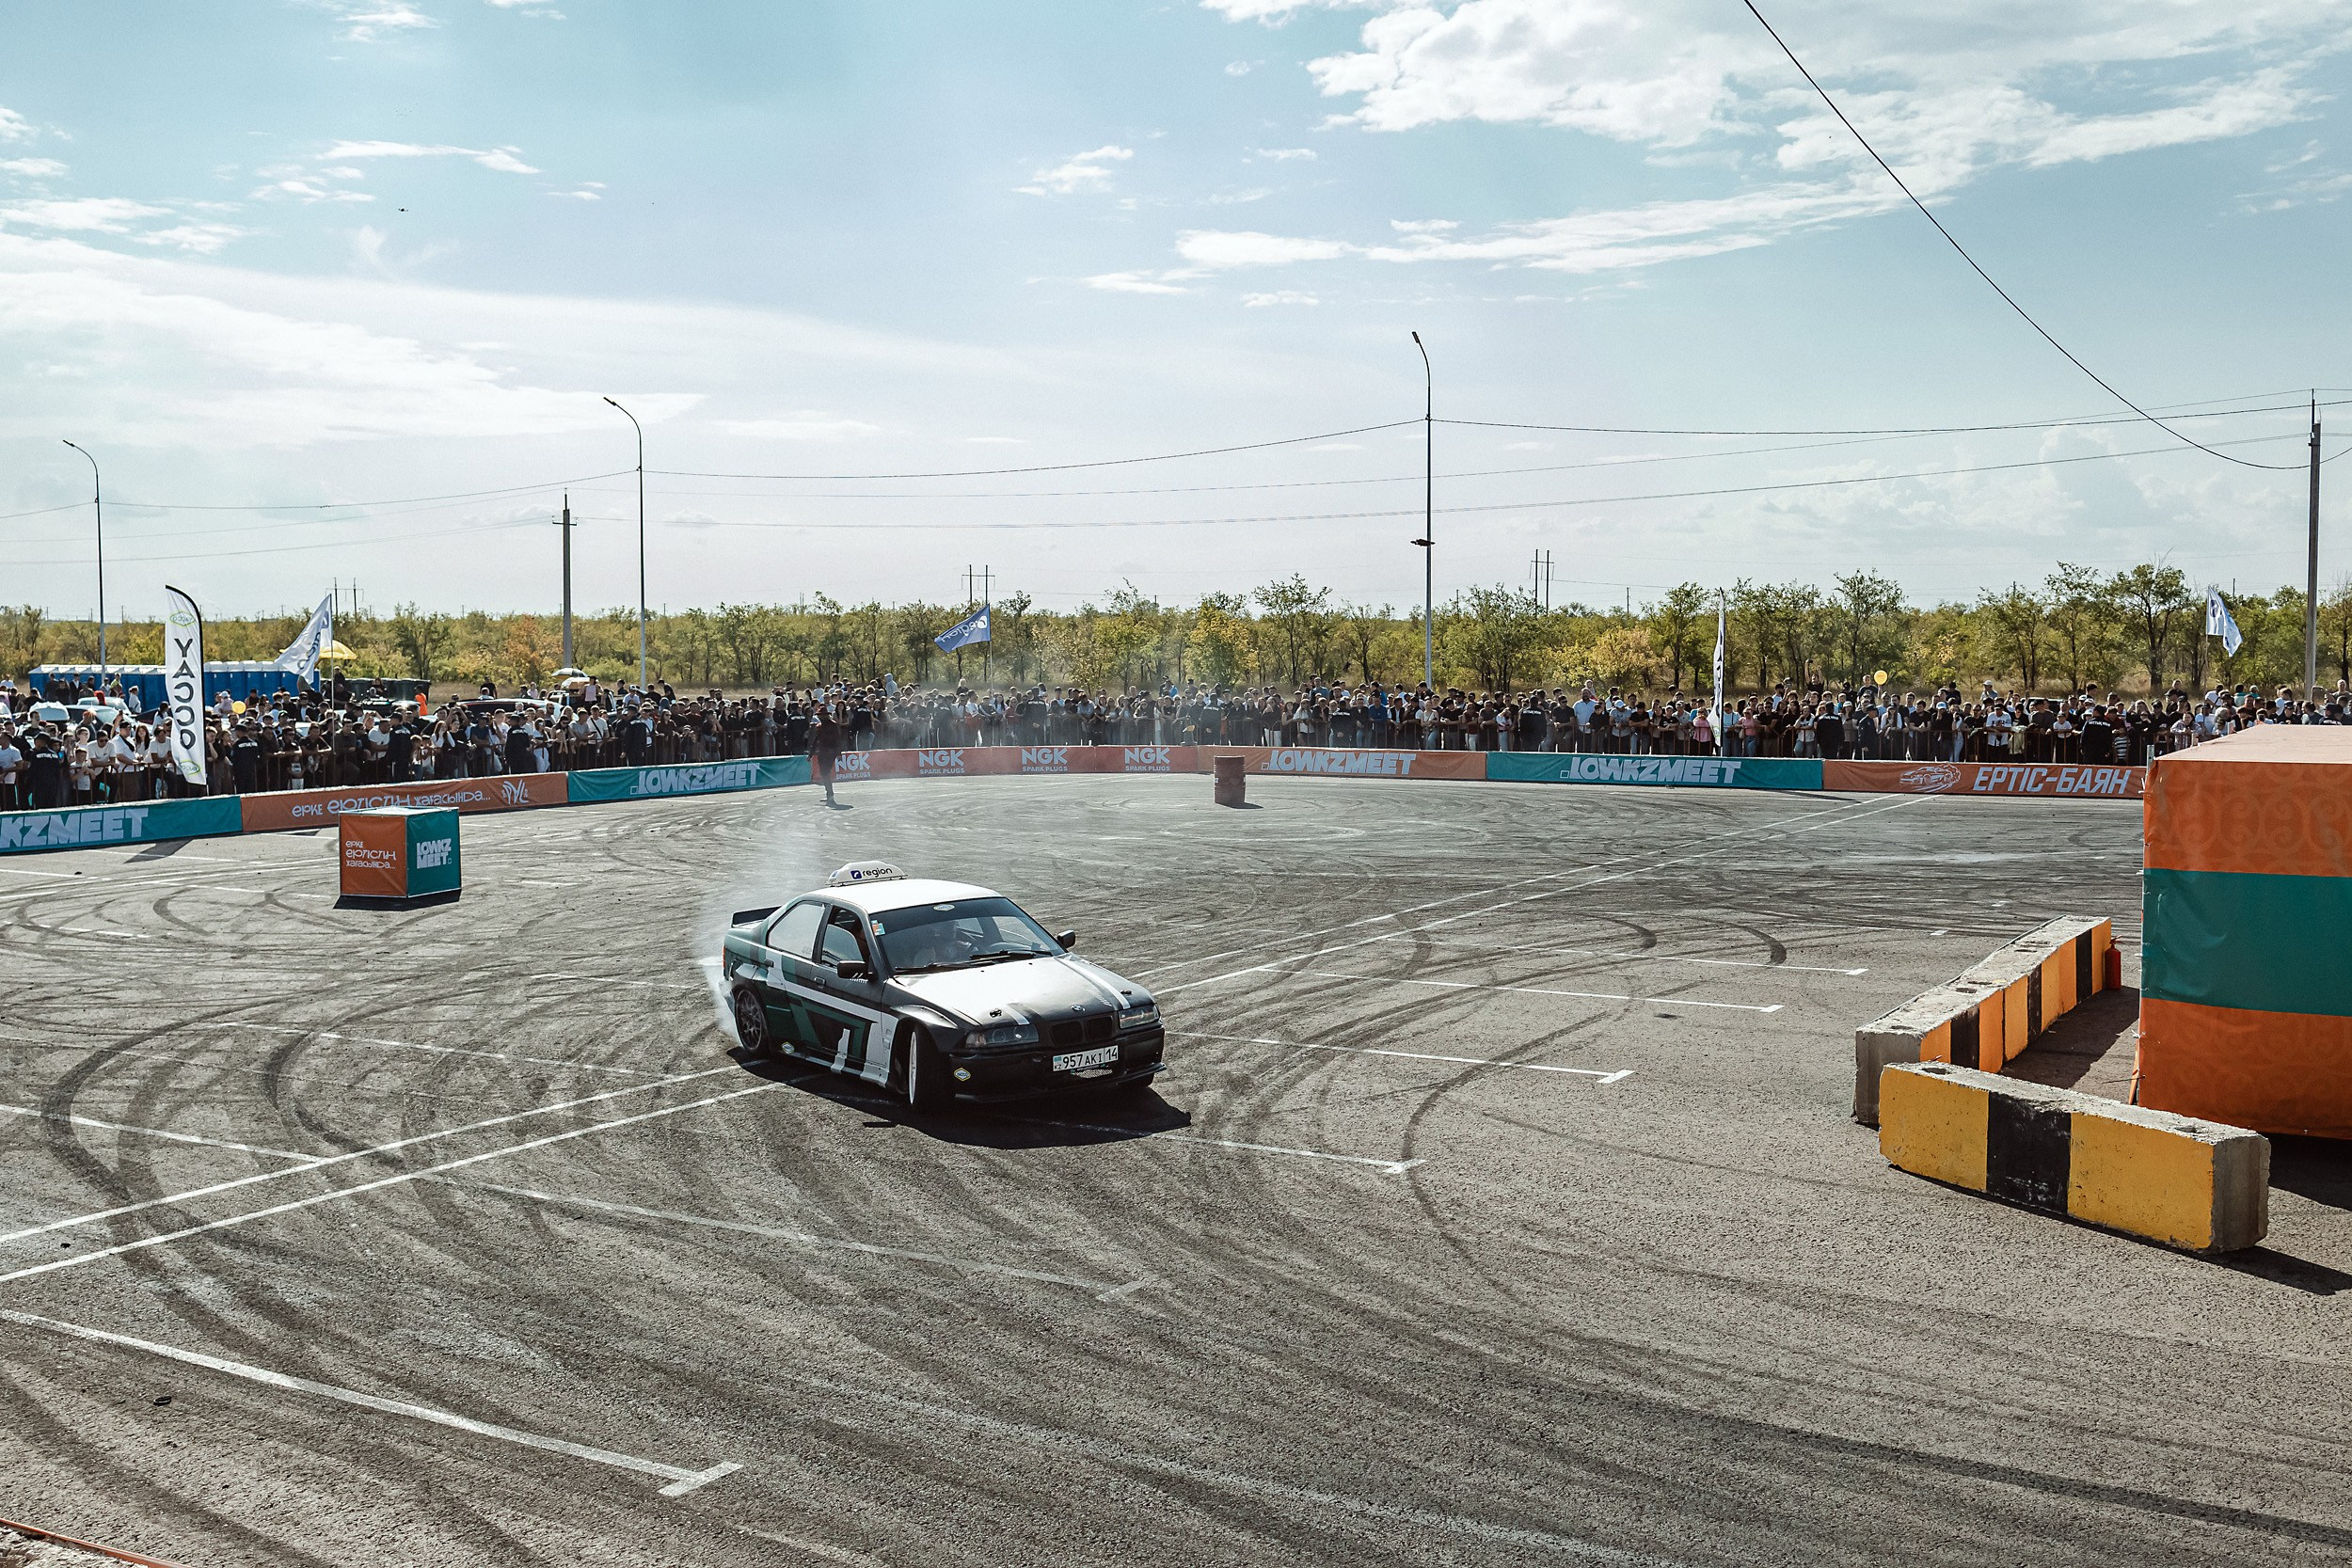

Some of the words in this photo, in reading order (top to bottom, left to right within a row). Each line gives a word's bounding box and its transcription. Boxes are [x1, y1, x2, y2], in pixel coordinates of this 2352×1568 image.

[834, 752, 870, 772] NGK
[918, 749, 964, 767] NGK
[1022, 748, 1068, 765] NGK
[1124, 747, 1170, 764] NGK
[1972, 767, 2132, 795] ЕРТІС-БАЯН
[0, 807, 150, 848] KZMEET
[862, 867, 893, 878] region
[1062, 1053, 1084, 1069] 957
[1085, 1053, 1103, 1066] AKI
[1106, 1047, 1118, 1061] 14
